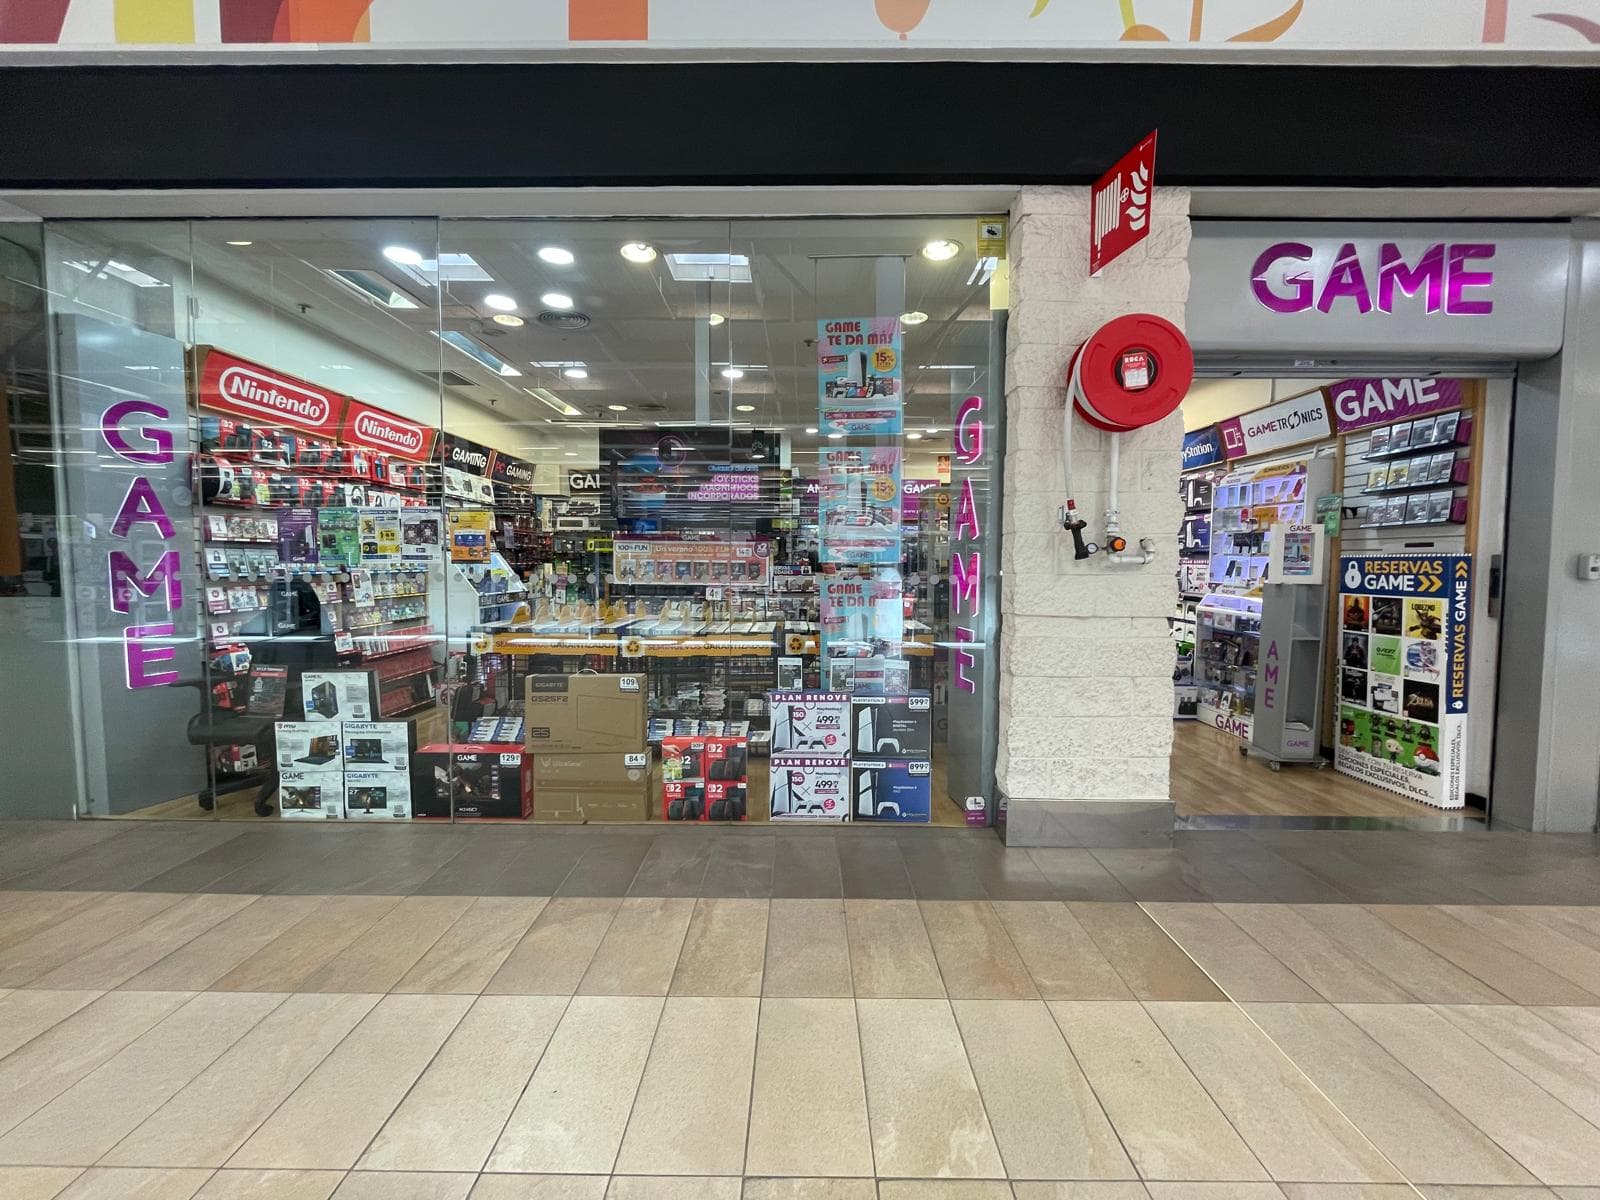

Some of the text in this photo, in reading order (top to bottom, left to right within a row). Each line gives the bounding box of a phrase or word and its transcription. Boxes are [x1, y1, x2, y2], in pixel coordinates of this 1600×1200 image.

[1250, 242, 1496, 316] GAME
[825, 322, 861, 333] GAME
[827, 335, 842, 346] TE
[845, 334, 864, 346] DA
[231, 375, 321, 419] Nintendo
[1335, 378, 1440, 421] GAME
[361, 418, 418, 447] Nintendo
[452, 447, 487, 468] GAMING
[506, 465, 532, 481] GAMING
[1289, 525, 1313, 533] GAME
[100, 400, 183, 690] GAME
[952, 395, 983, 695] GAME
[1365, 560, 1443, 574] RESERVAS
[827, 584, 863, 594] GAME
[1364, 574, 1415, 592] GAME
[829, 596, 844, 607] TE
[1452, 580, 1467, 698] RESERVAS GAME
[817, 715, 834, 724] 499
[1215, 714, 1249, 739] GAME
[1287, 740, 1312, 748] GAME
[1338, 753, 1369, 770] EDICIONES
[1338, 760, 1364, 776] REGALOS
[282, 772, 304, 780] GAME
[815, 780, 833, 788] 499
